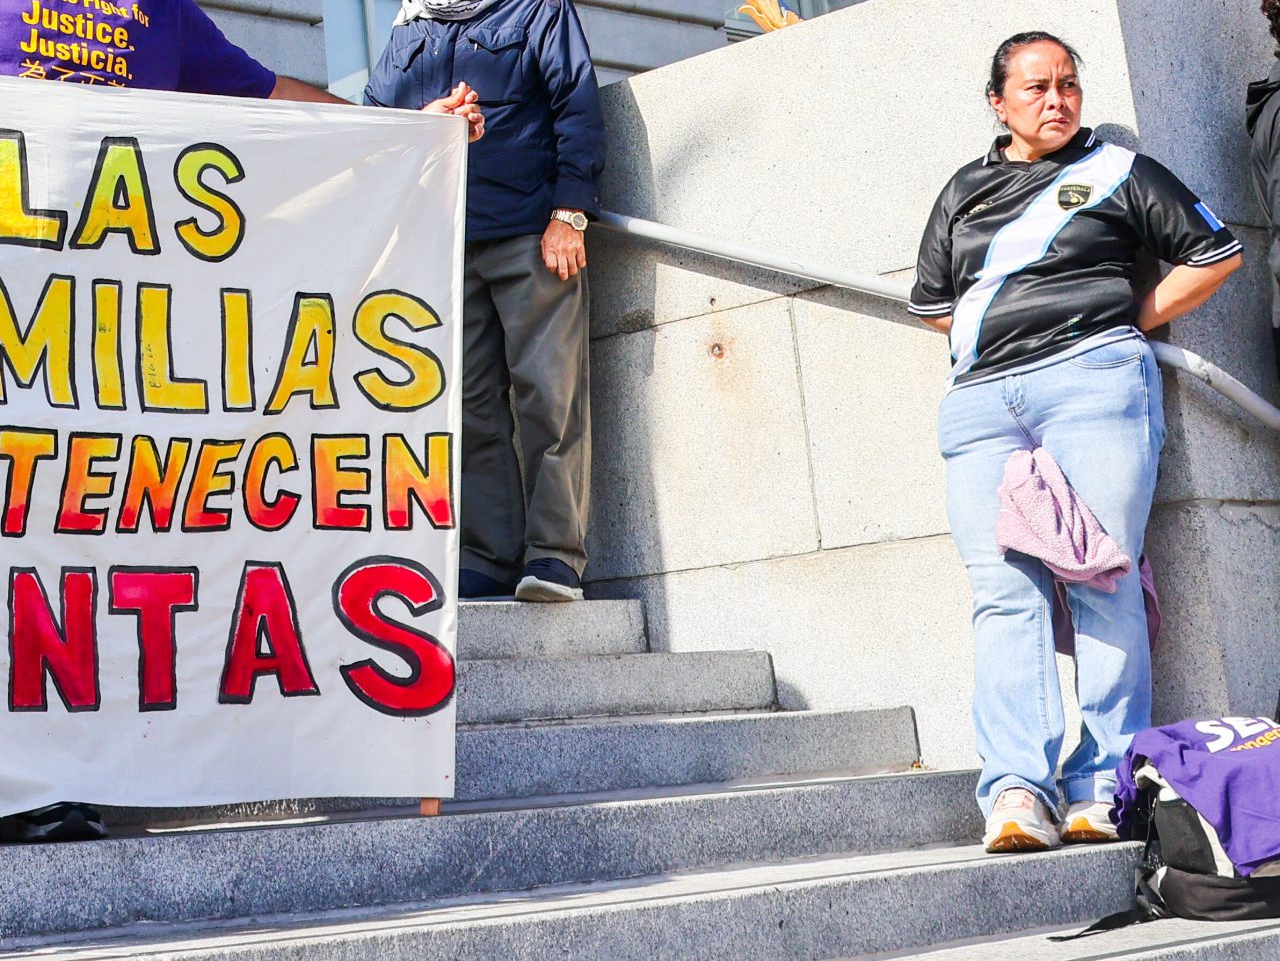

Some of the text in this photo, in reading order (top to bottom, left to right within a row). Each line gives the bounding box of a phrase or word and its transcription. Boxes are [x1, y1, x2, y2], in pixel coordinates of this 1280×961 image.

[22, 0, 136, 51] Justice.
[131, 4, 151, 28] for
[20, 27, 133, 80] Justicia.
